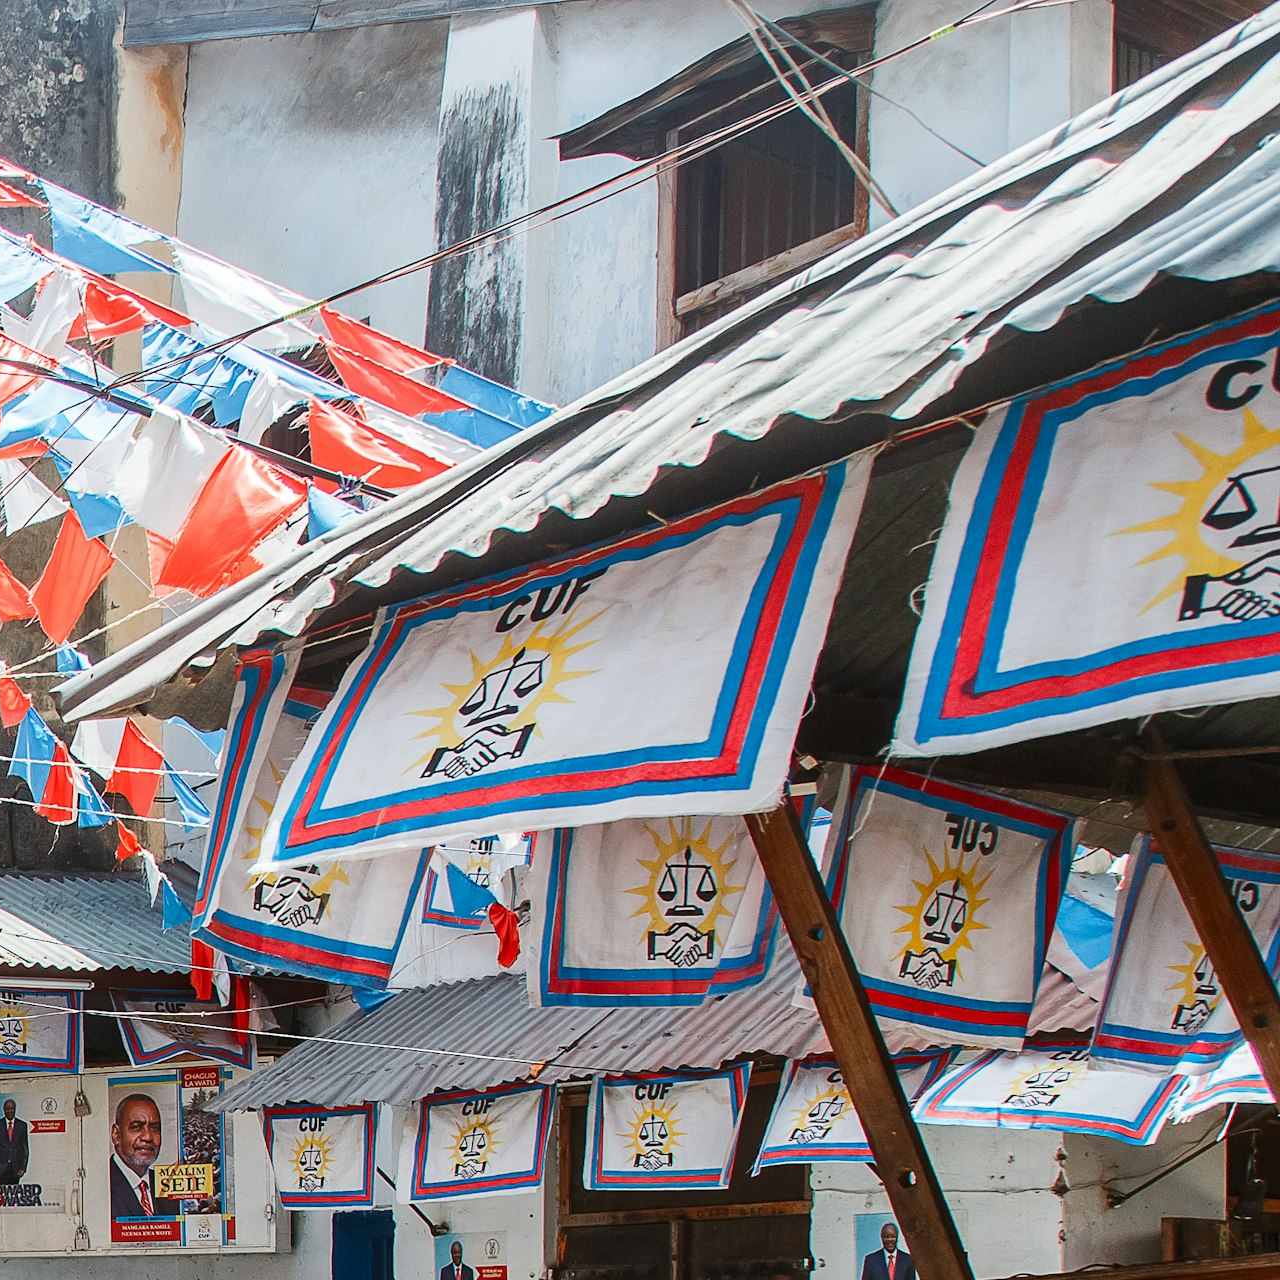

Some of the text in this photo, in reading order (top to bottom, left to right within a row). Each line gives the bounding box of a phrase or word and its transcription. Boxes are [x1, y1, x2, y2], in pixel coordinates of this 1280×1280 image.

[495, 566, 610, 634] CUF
[154, 1002, 186, 1013] CUF
[184, 1072, 216, 1080] CHAGUO
[194, 1079, 216, 1087] WATU
[634, 1083, 672, 1101] CUF
[461, 1100, 496, 1117] CUF
[298, 1117, 328, 1133] CUF
[160, 1167, 206, 1176] MAALIM
[161, 1177, 206, 1193] SEIF
